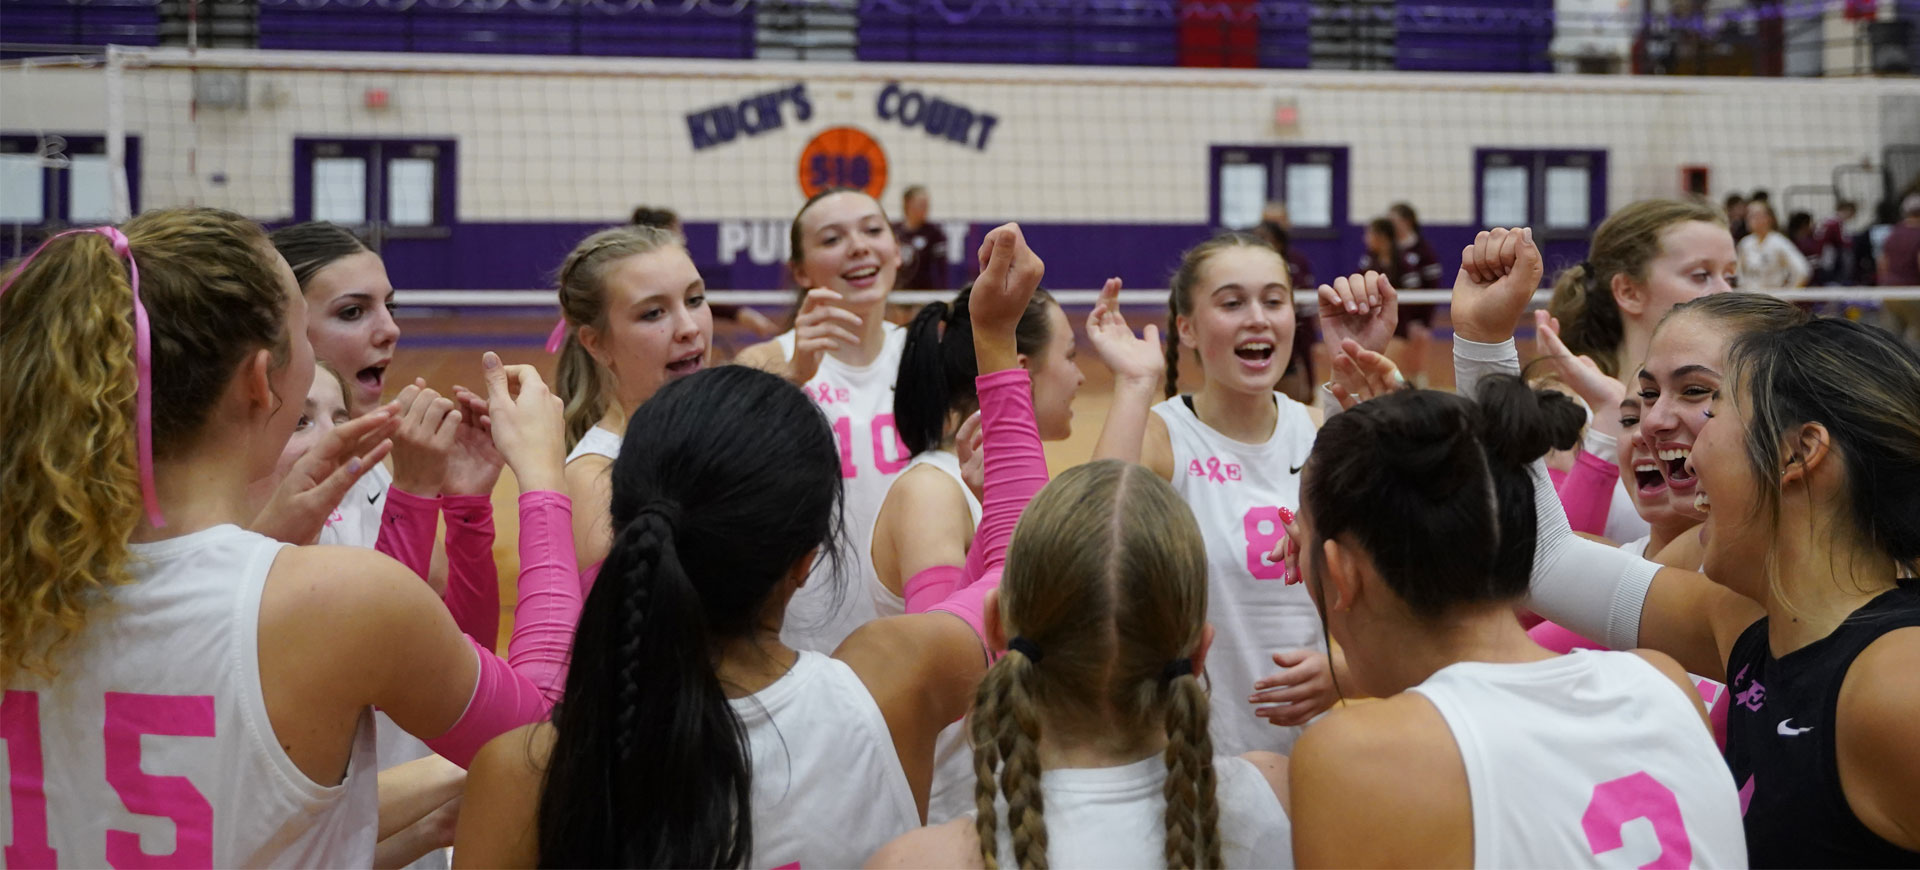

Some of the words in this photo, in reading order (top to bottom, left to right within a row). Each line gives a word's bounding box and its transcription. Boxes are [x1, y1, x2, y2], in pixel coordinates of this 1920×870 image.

[876, 80, 998, 150] COURT
[833, 414, 911, 478] 10
[1243, 506, 1286, 580] 8
[0, 689, 216, 870] 15
